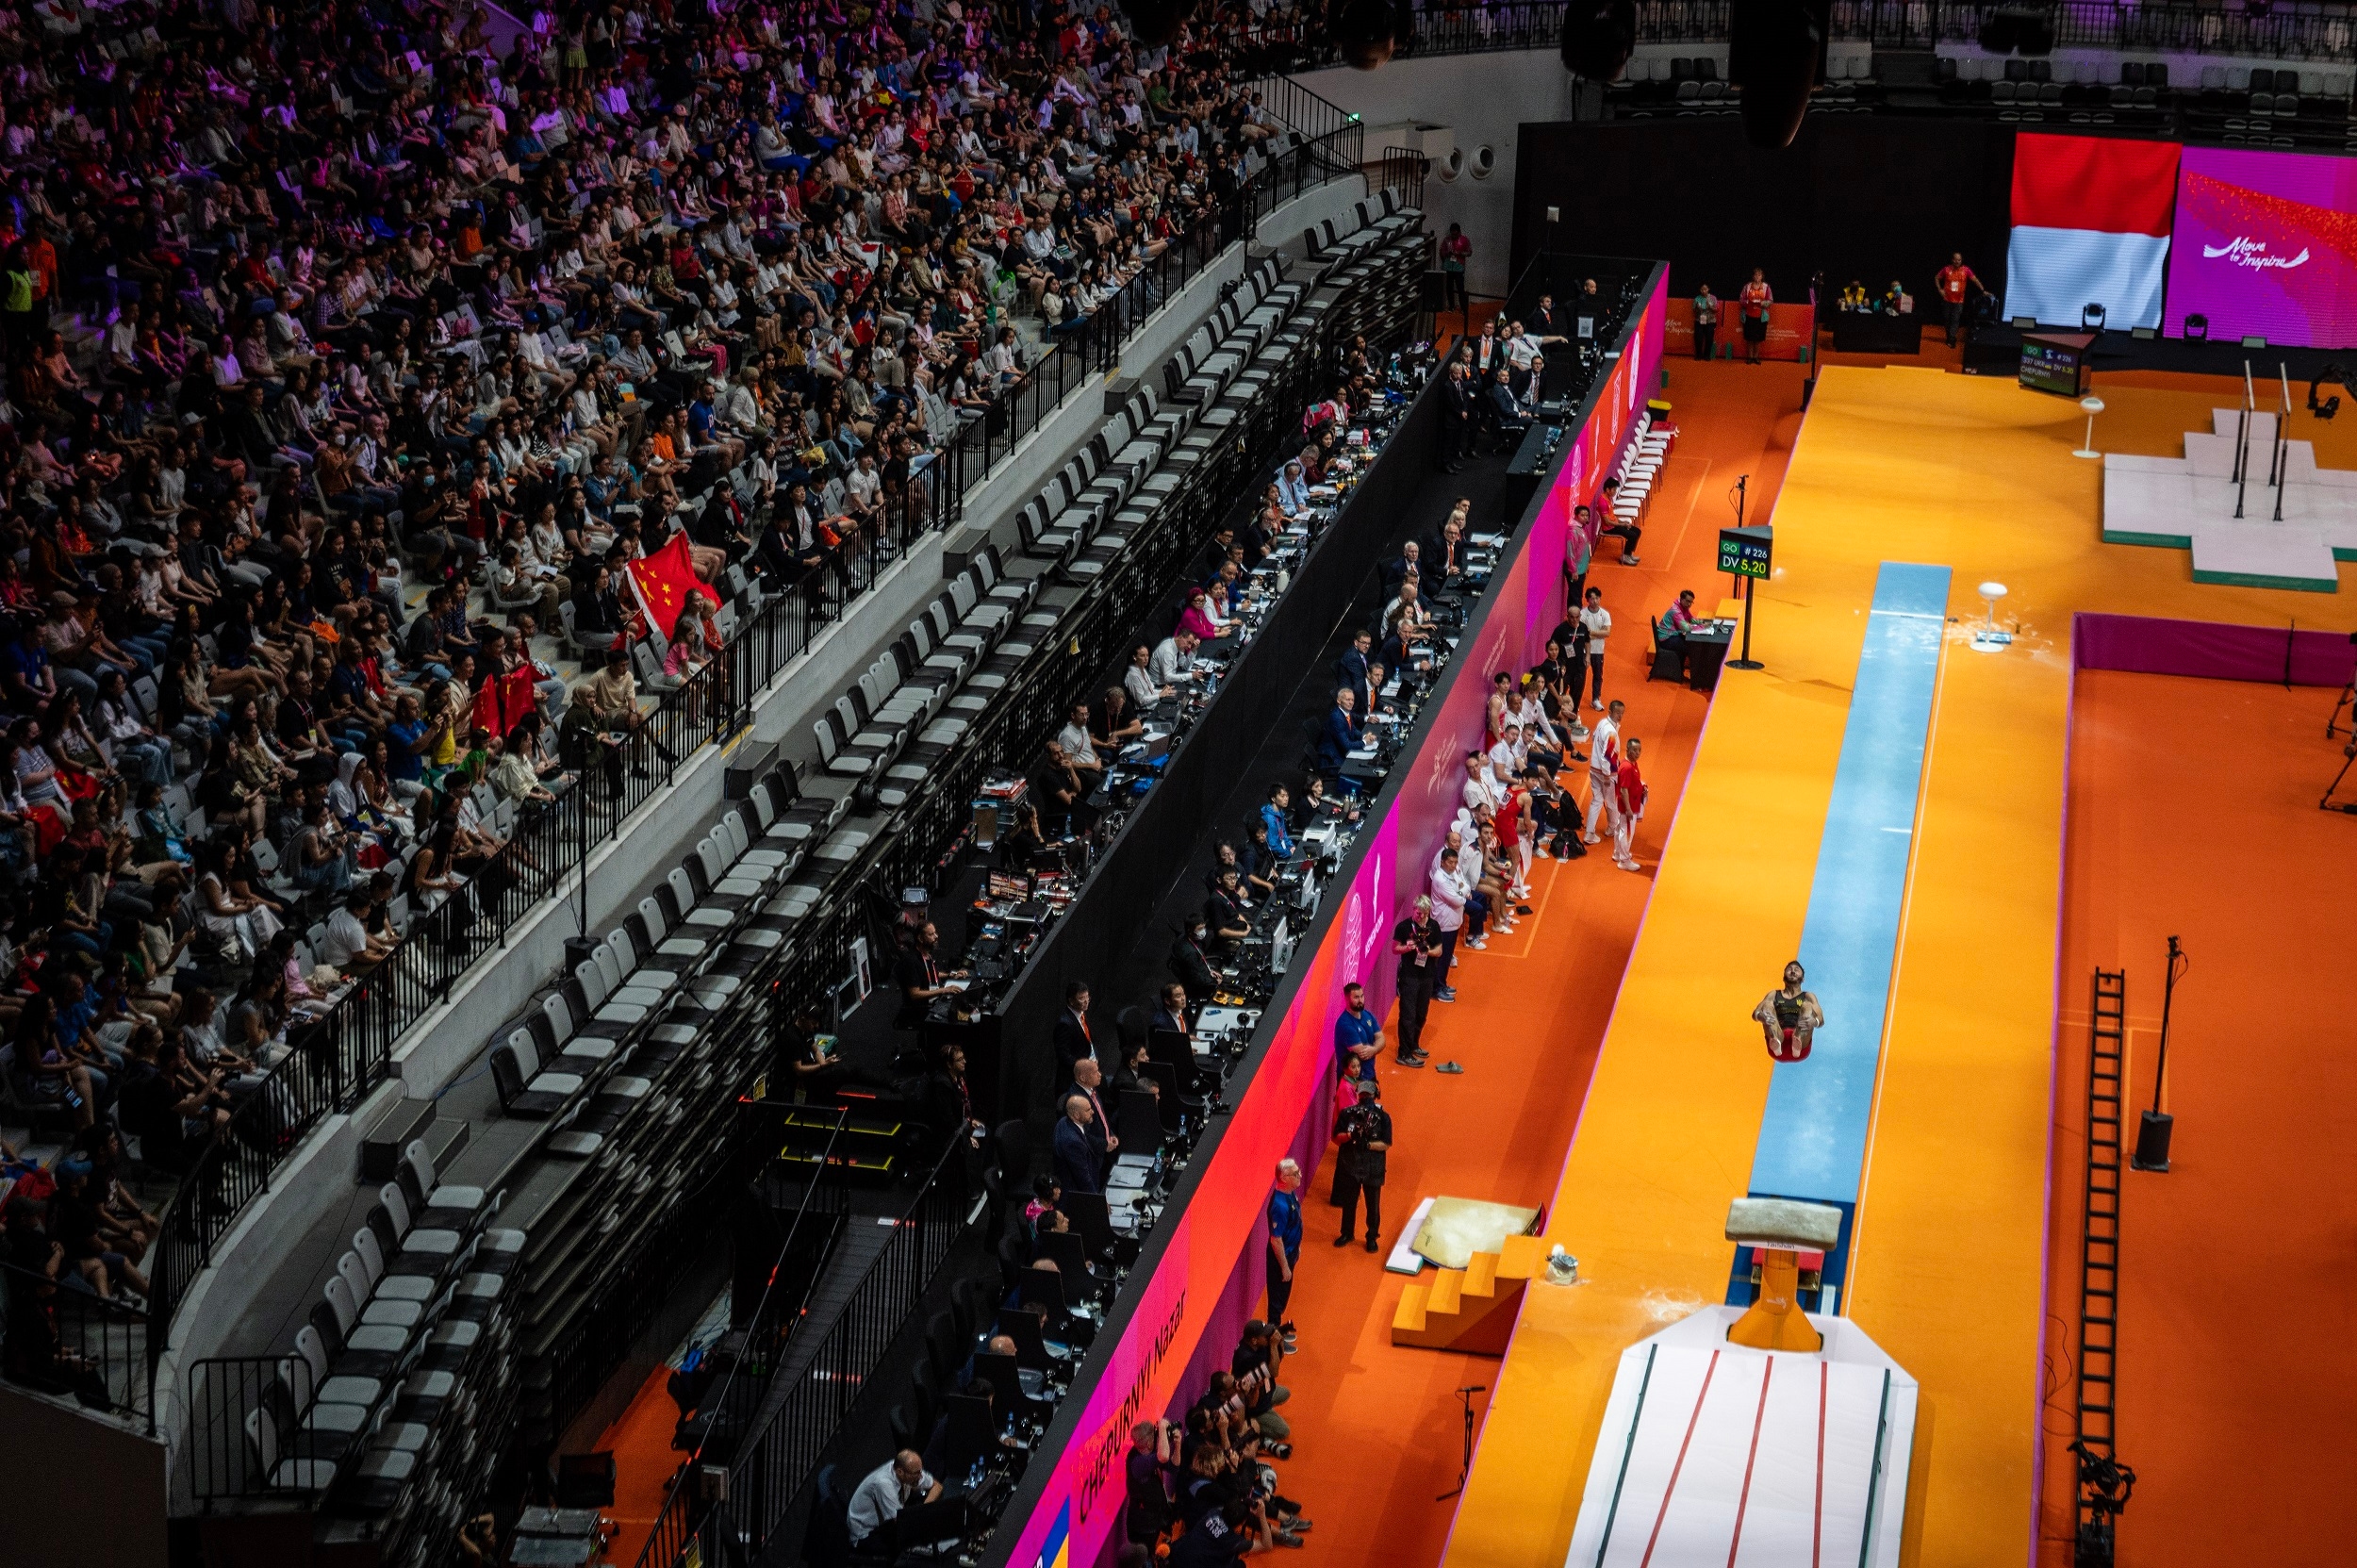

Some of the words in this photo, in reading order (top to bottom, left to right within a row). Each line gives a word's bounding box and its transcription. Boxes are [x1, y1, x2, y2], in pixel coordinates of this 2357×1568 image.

[2229, 236, 2266, 255] Move
[2230, 254, 2241, 262] to
[2238, 251, 2287, 272] Inspire
[1723, 543, 1738, 553] GO
[1744, 547, 1752, 555] #
[1754, 548, 1768, 559] 226
[1722, 555, 1739, 569] DV
[1740, 558, 1767, 574] 5.20
[1080, 1350, 1151, 1525] CHEPURNYI
[1154, 1288, 1186, 1375] Nazar
